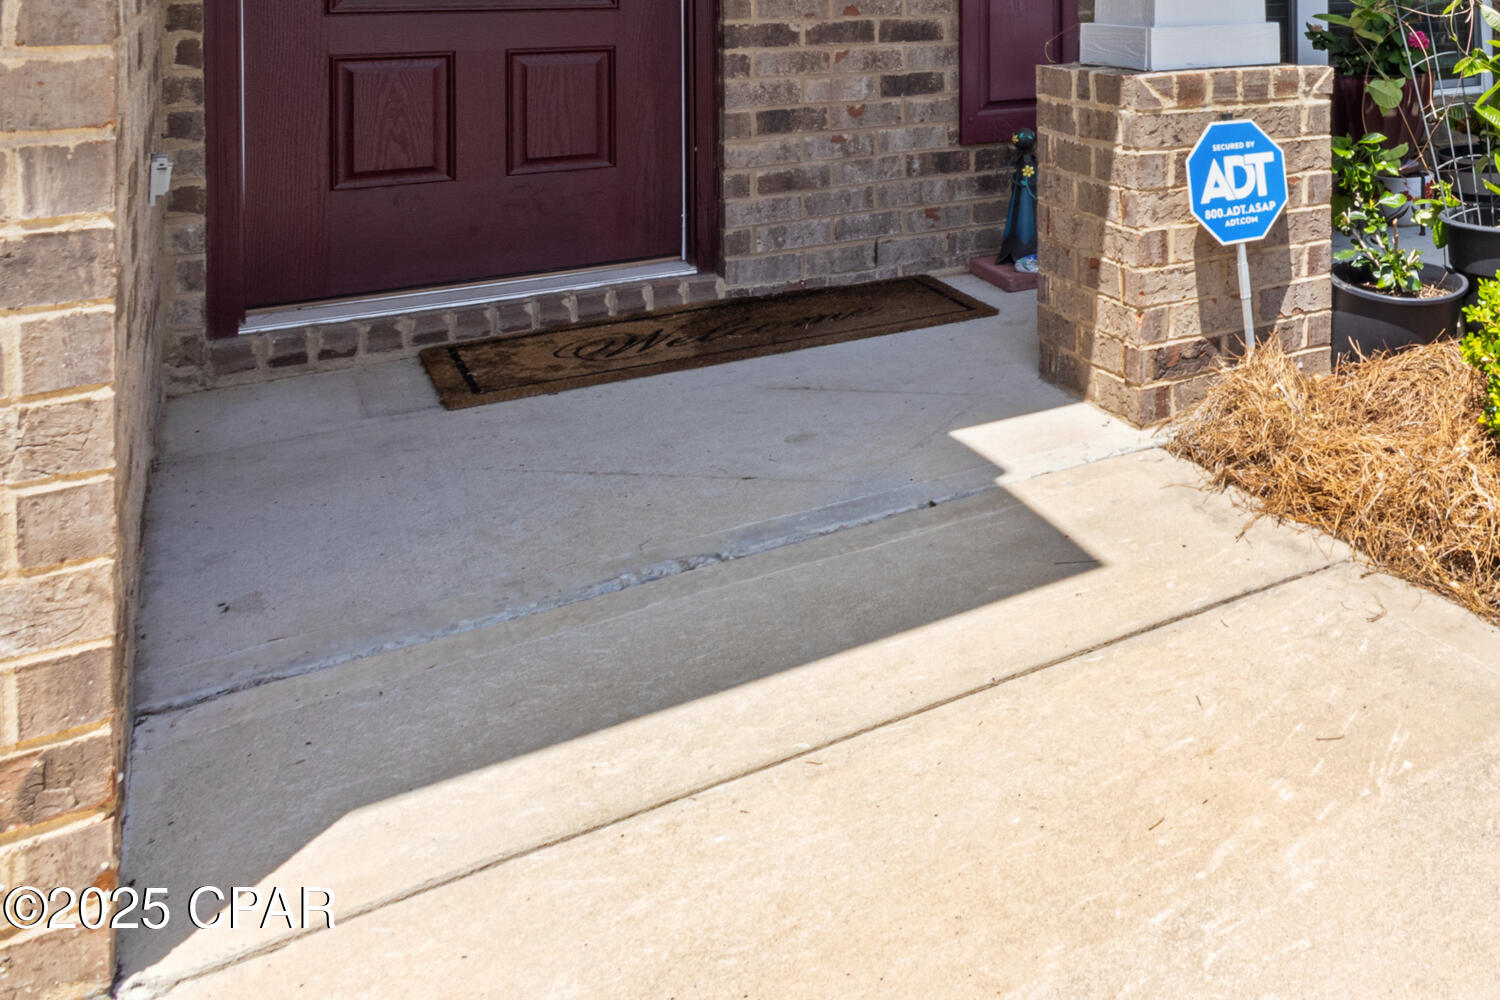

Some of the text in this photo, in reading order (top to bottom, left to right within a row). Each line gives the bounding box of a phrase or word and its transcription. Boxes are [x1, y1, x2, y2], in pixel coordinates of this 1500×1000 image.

[1212, 140, 1255, 152] SECURED BY
[1200, 151, 1275, 205] ADT
[1204, 200, 1277, 220] 800.ADT.ASAP
[1225, 216, 1258, 228] ADT.COM
